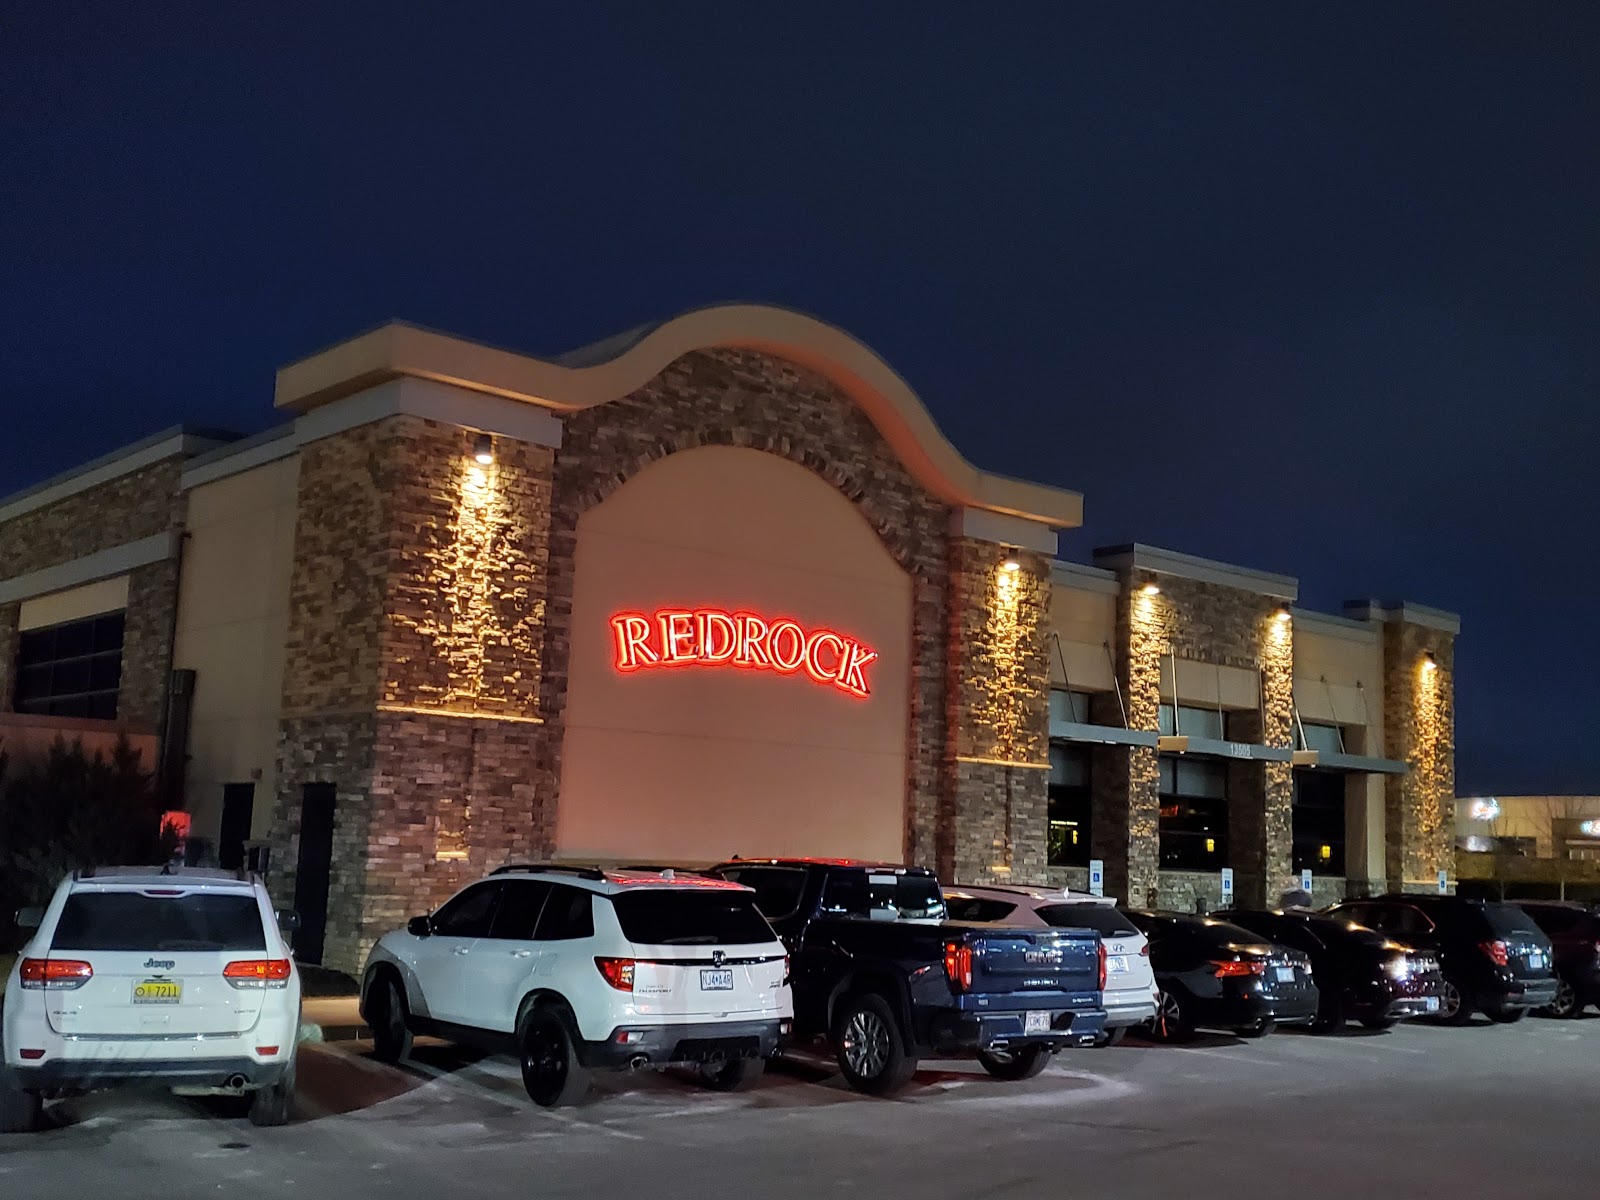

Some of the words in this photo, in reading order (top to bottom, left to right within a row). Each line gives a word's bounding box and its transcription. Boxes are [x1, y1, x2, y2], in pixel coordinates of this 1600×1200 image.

[611, 609, 877, 698] REDROCK
[1230, 743, 1251, 757] 13505
[143, 958, 175, 970] Jeep
[155, 986, 177, 998] 7211
